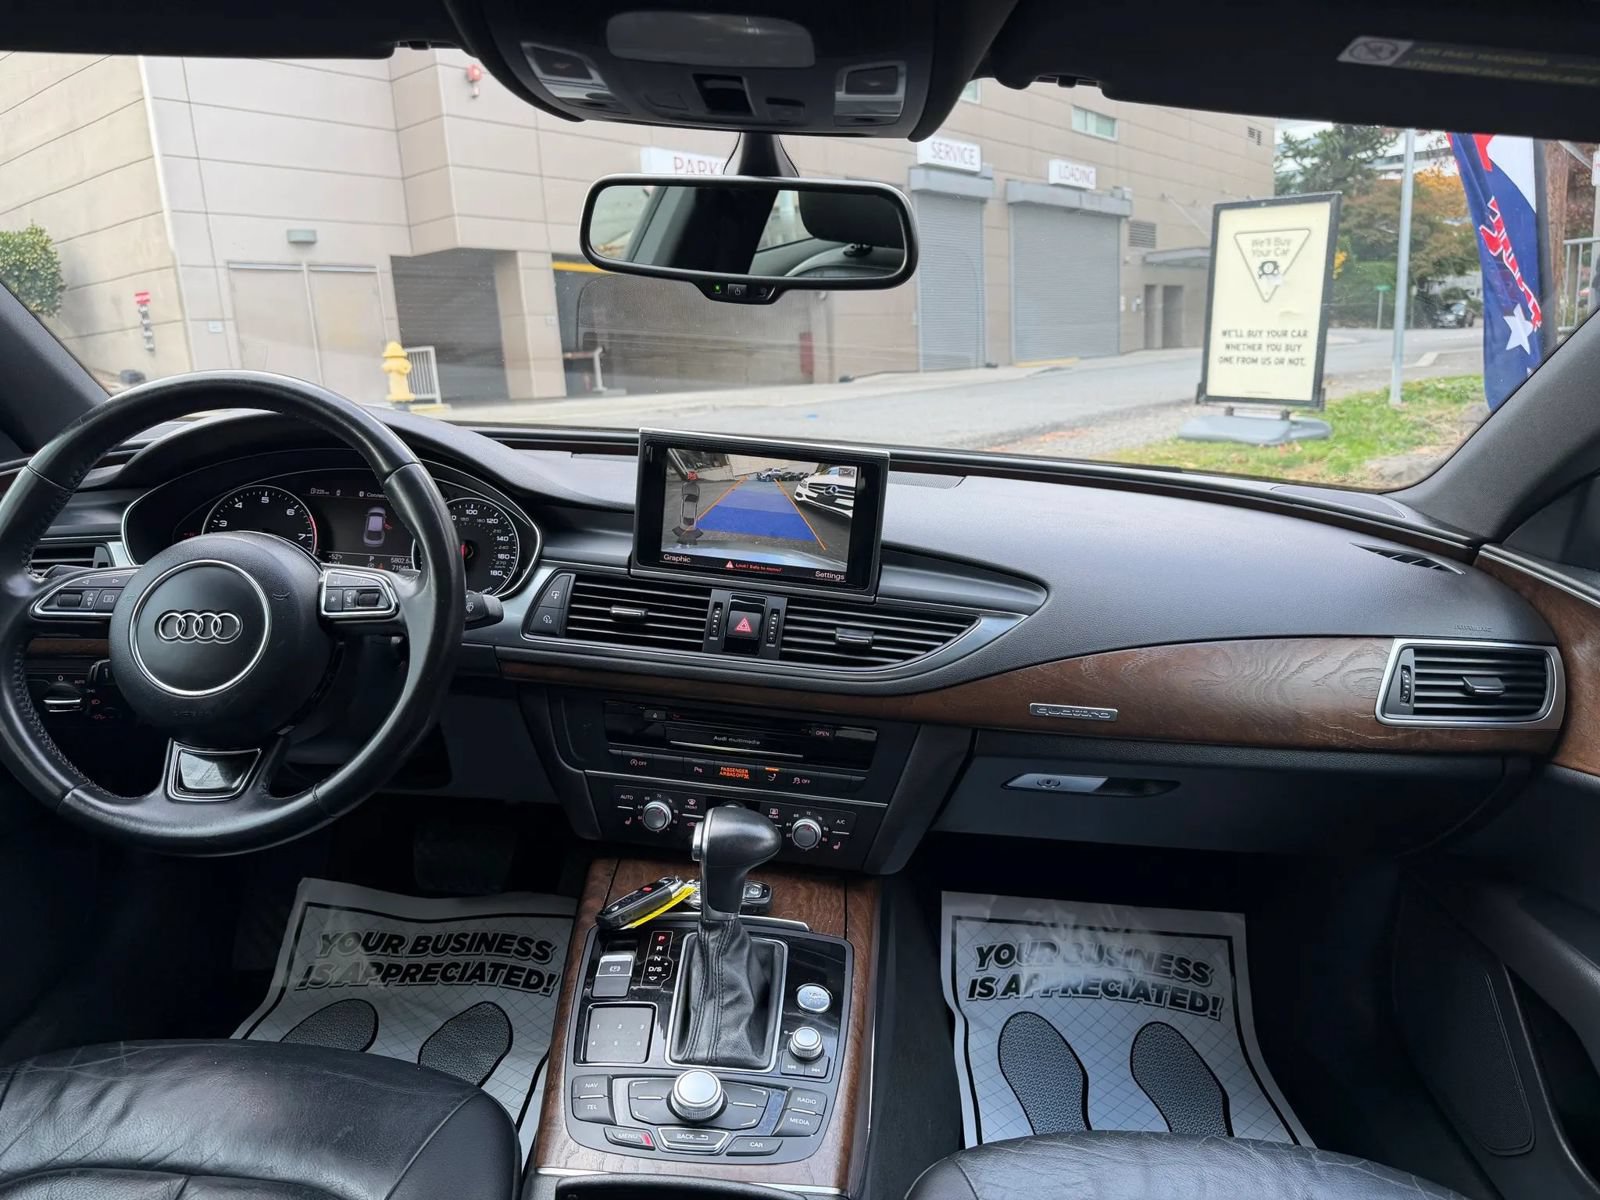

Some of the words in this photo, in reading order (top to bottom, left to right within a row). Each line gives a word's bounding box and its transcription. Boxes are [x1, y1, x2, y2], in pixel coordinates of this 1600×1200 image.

[930, 141, 976, 166] SERVICE
[673, 156, 719, 175] PARK
[1058, 164, 1094, 186] LOADING
[1221, 329, 1244, 338] WE'LL
[1247, 329, 1263, 338] BUY
[1266, 329, 1288, 338] YOUR
[1291, 329, 1308, 339] CAR
[1225, 343, 1263, 352] WHETHER
[1266, 343, 1282, 352] YOU
[1284, 343, 1302, 352] BUY
[1218, 356, 1234, 365] ONE
[1236, 356, 1258, 365] FROM
[1260, 357, 1272, 366] US
[1274, 357, 1285, 366] OR
[261, 496, 269, 504] 5
[286, 508, 295, 516] 6
[298, 533, 306, 541] 7
[663, 553, 691, 564] Graphic
[815, 570, 846, 581] Settings
[728, 737, 761, 746] multimedia
[720, 766, 749, 774] PASSENGER
[319, 930, 406, 957] YOUR
[407, 931, 557, 963] BUSINESS
[974, 940, 1059, 971] YOUR
[1063, 942, 1213, 987] BUSINESS
[295, 962, 334, 991] IS
[335, 960, 561, 996] APPRECIATED!
[967, 975, 998, 1001] IS
[1001, 972, 1224, 1020] APPRECIATED!
[797, 1096, 817, 1105] RADIO
[789, 1117, 810, 1127] MEDIA
[618, 1132, 639, 1140] MENU
[676, 1133, 694, 1141] BACK
